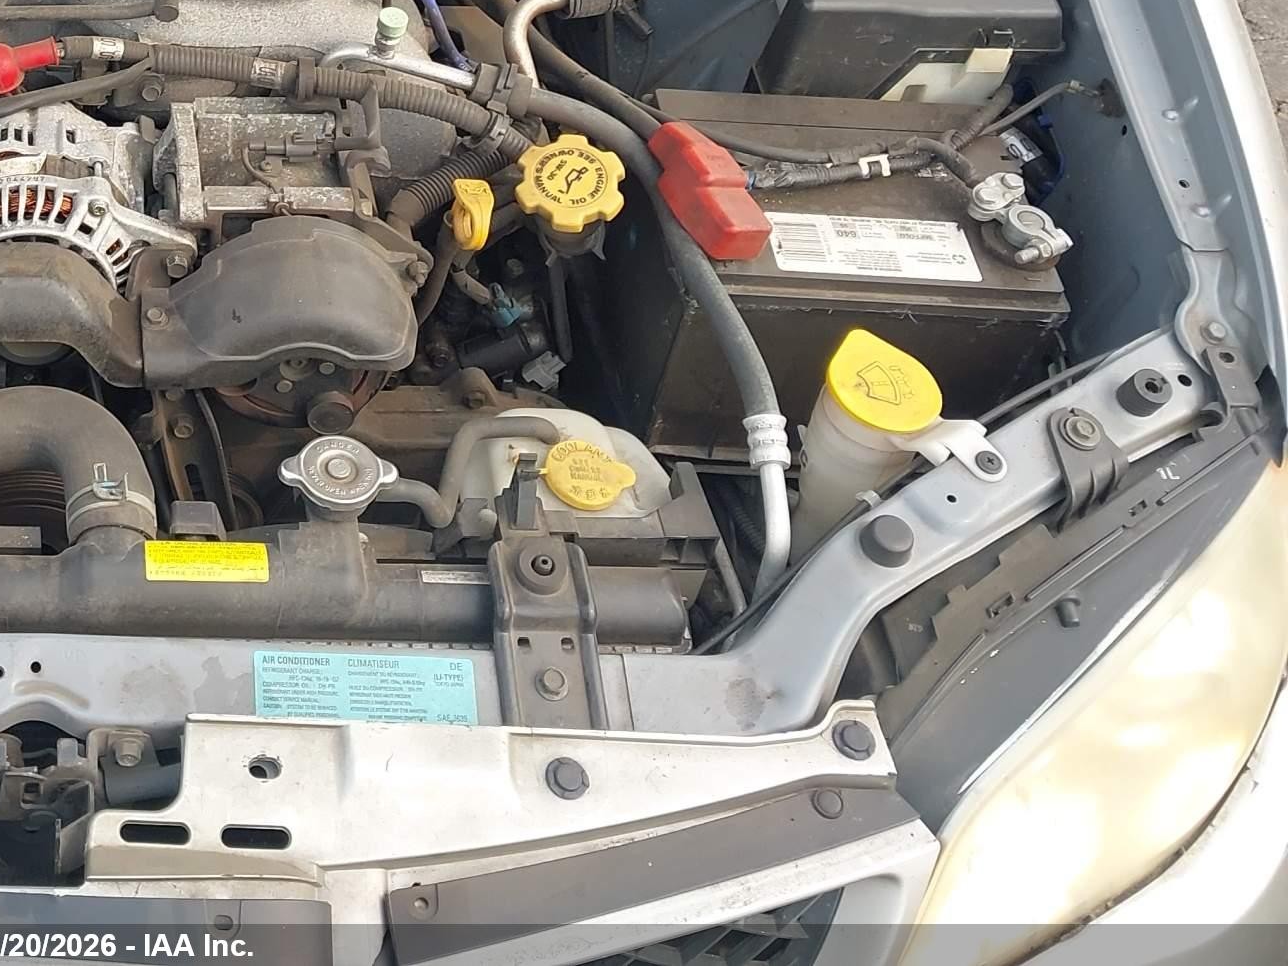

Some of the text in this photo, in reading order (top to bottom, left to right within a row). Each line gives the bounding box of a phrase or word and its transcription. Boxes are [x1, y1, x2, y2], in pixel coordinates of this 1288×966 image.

[577, 151, 596, 164] SEE
[534, 175, 563, 204] MANUAL
[569, 167, 605, 205] ENGINE OIL
[262, 655, 331, 666] AIR CONDITIONER
[347, 658, 400, 669] CLIMATISEUR
